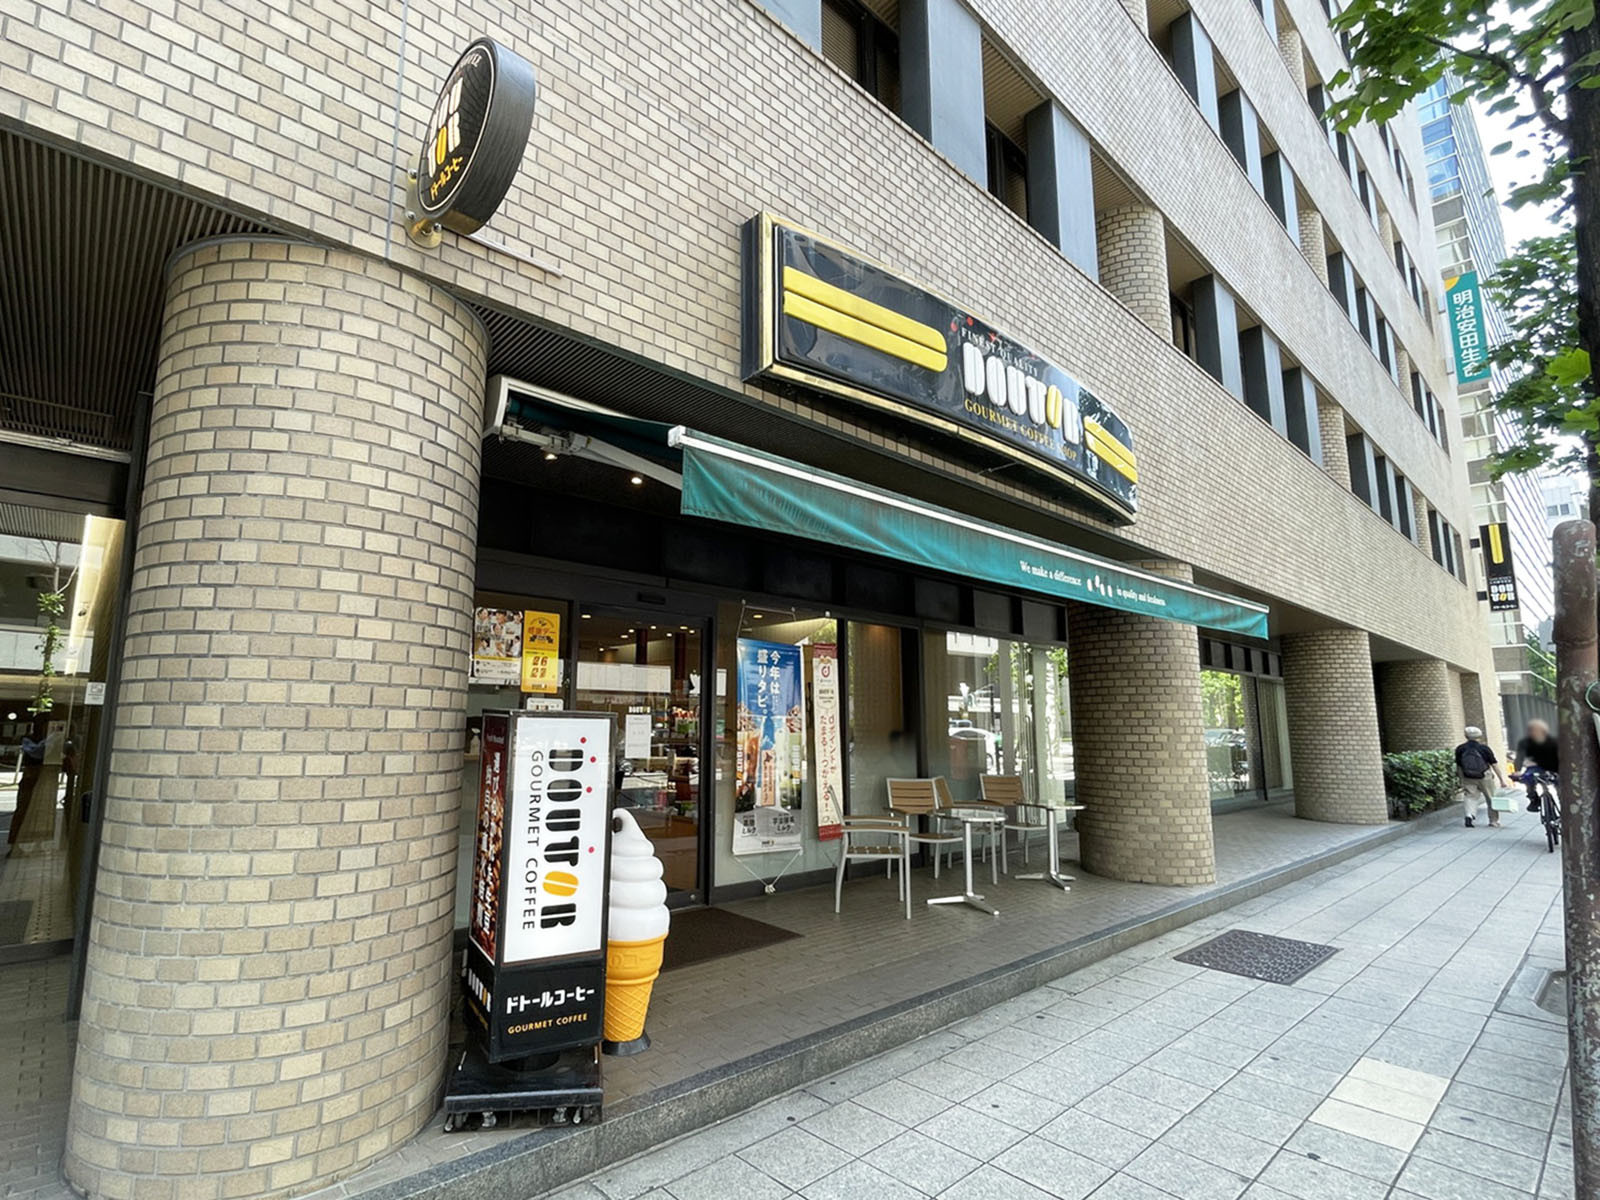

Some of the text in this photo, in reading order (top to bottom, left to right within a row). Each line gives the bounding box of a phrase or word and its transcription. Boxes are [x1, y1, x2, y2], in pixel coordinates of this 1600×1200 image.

[961, 328, 996, 355] FINEST
[963, 342, 1080, 445] DOUTOR
[964, 398, 1018, 433] GOURMET
[1019, 424, 1055, 450] COFFEE
[1019, 560, 1031, 574] We
[1031, 566, 1048, 578] make
[1049, 571, 1053, 579] a
[523, 750, 543, 930] GOURMET COFFEE
[540, 749, 584, 929] DOUTOR
[506, 985, 595, 1014] ドトールコーヒー
[507, 1012, 588, 1035] GOURMET COFFEE
